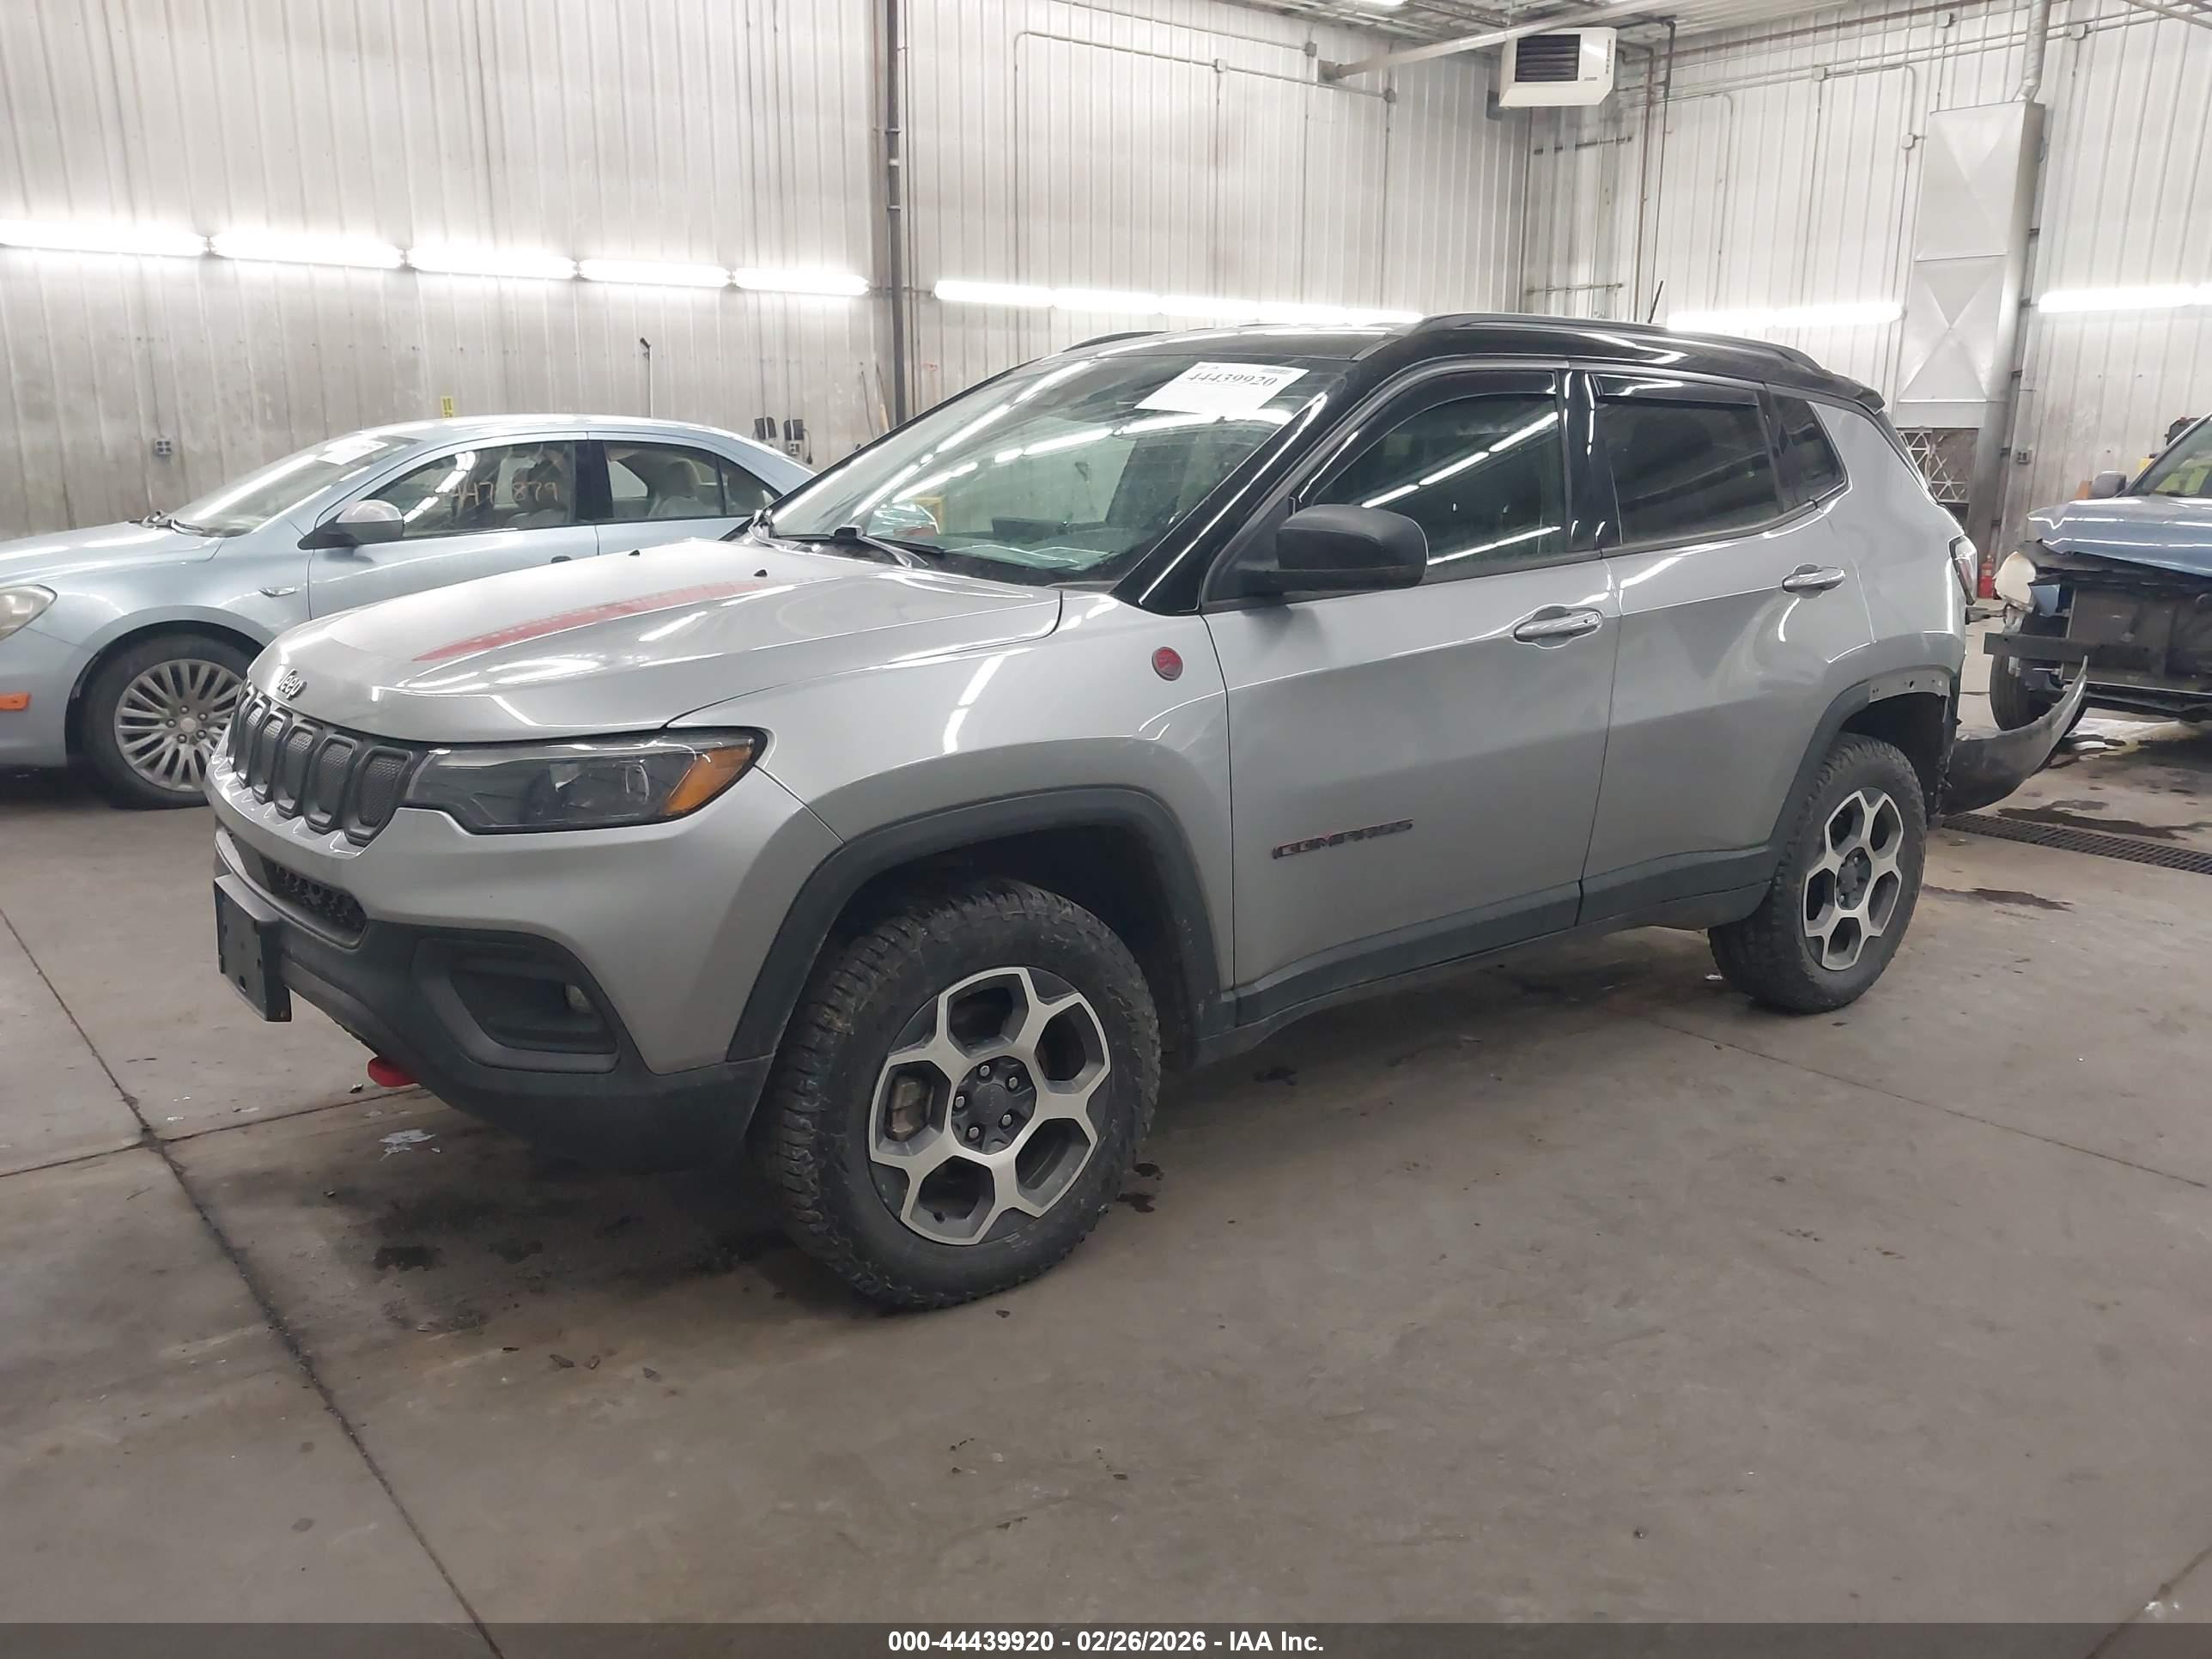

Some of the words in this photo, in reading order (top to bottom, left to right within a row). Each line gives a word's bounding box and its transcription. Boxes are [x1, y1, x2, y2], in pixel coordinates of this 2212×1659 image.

[1187, 372, 1279, 386] 44439920
[513, 481, 559, 502] 879
[276, 668, 307, 701] Jeep
